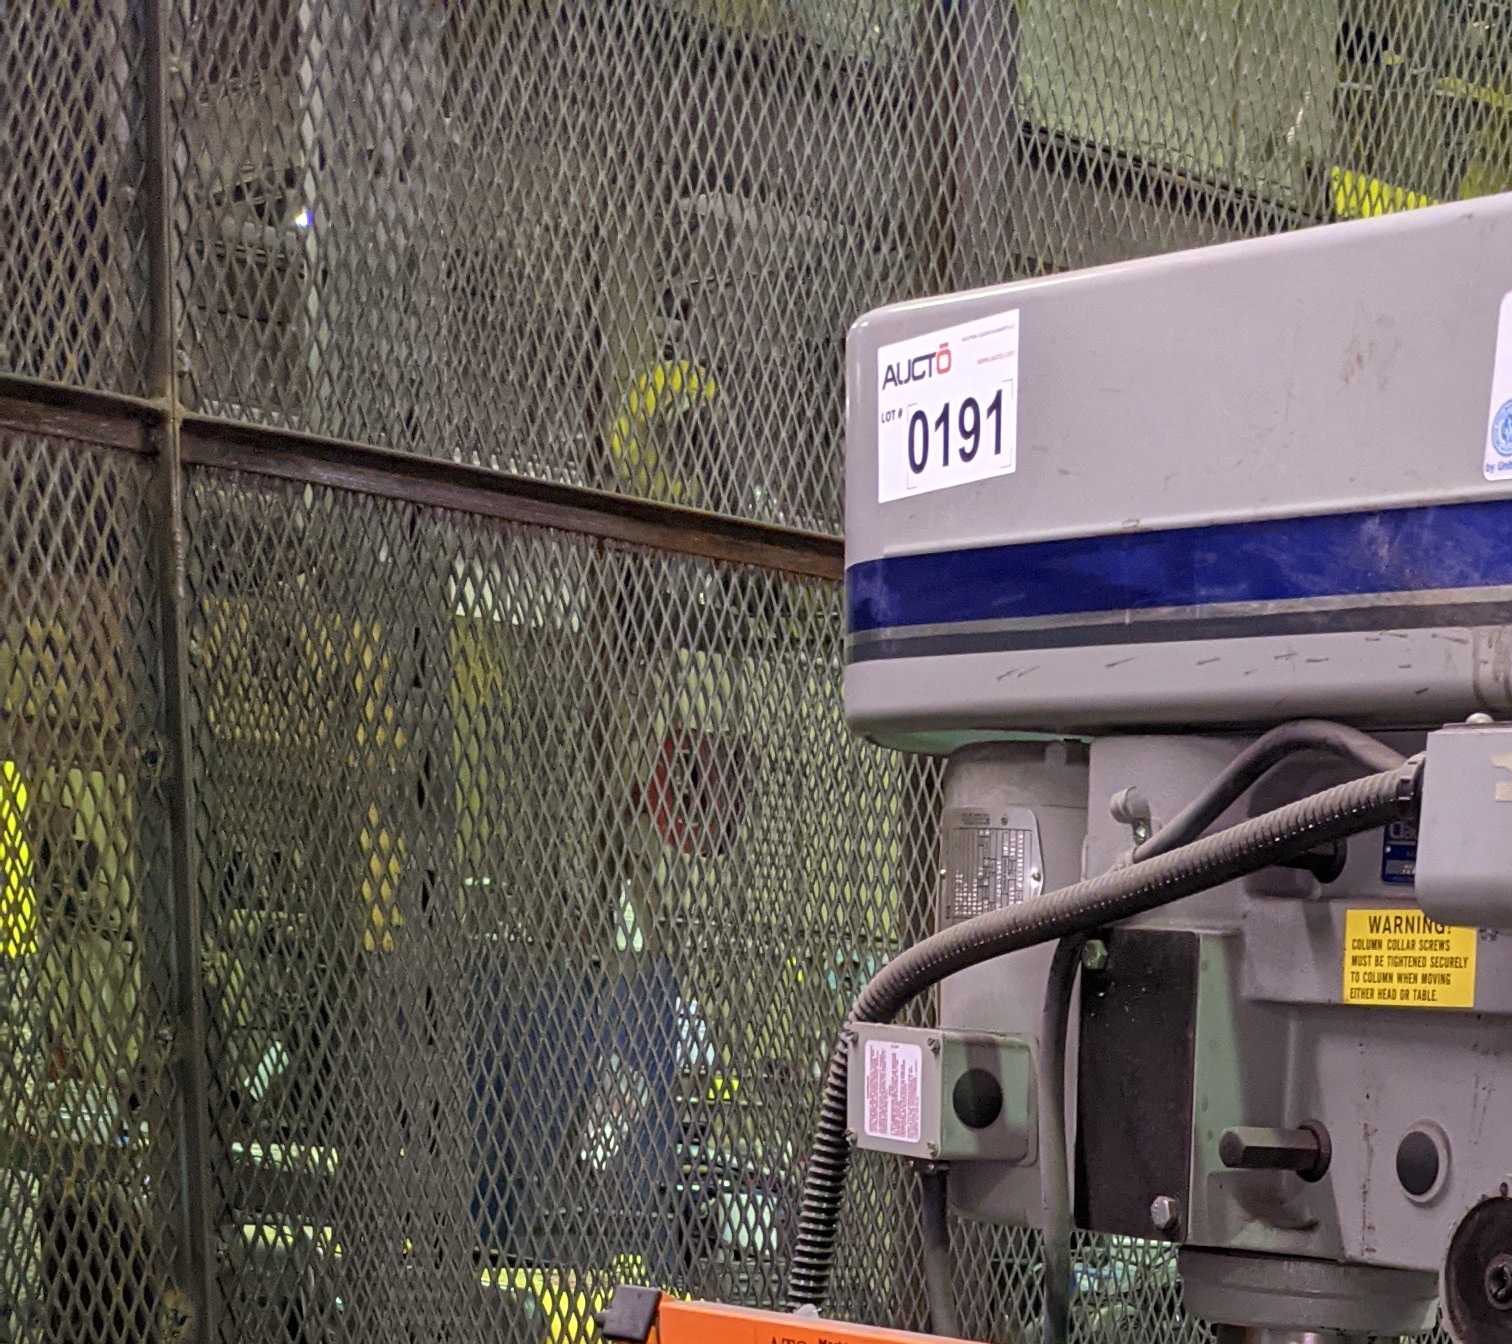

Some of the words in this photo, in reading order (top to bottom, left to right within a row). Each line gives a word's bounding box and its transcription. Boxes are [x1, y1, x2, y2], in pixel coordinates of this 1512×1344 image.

[881, 409, 896, 424] LOT
[908, 388, 1002, 474] 0191
[1352, 938, 1382, 950] COLUMN
[1387, 938, 1416, 951] COLLAR
[1419, 939, 1450, 952] SCREWS
[1351, 955, 1371, 967] MUST
[1375, 955, 1384, 967] BE
[1387, 955, 1426, 968] TIGHTENED
[1430, 956, 1469, 969] SECURELY
[1351, 971, 1360, 983] TO
[1362, 971, 1393, 984] COLUMN
[1397, 972, 1418, 984] WHEN
[1421, 972, 1451, 985] MOVING
[1350, 987, 1374, 1000] EITHER
[1377, 988, 1396, 1000] HEAD
[1399, 988, 1410, 1001] OR
